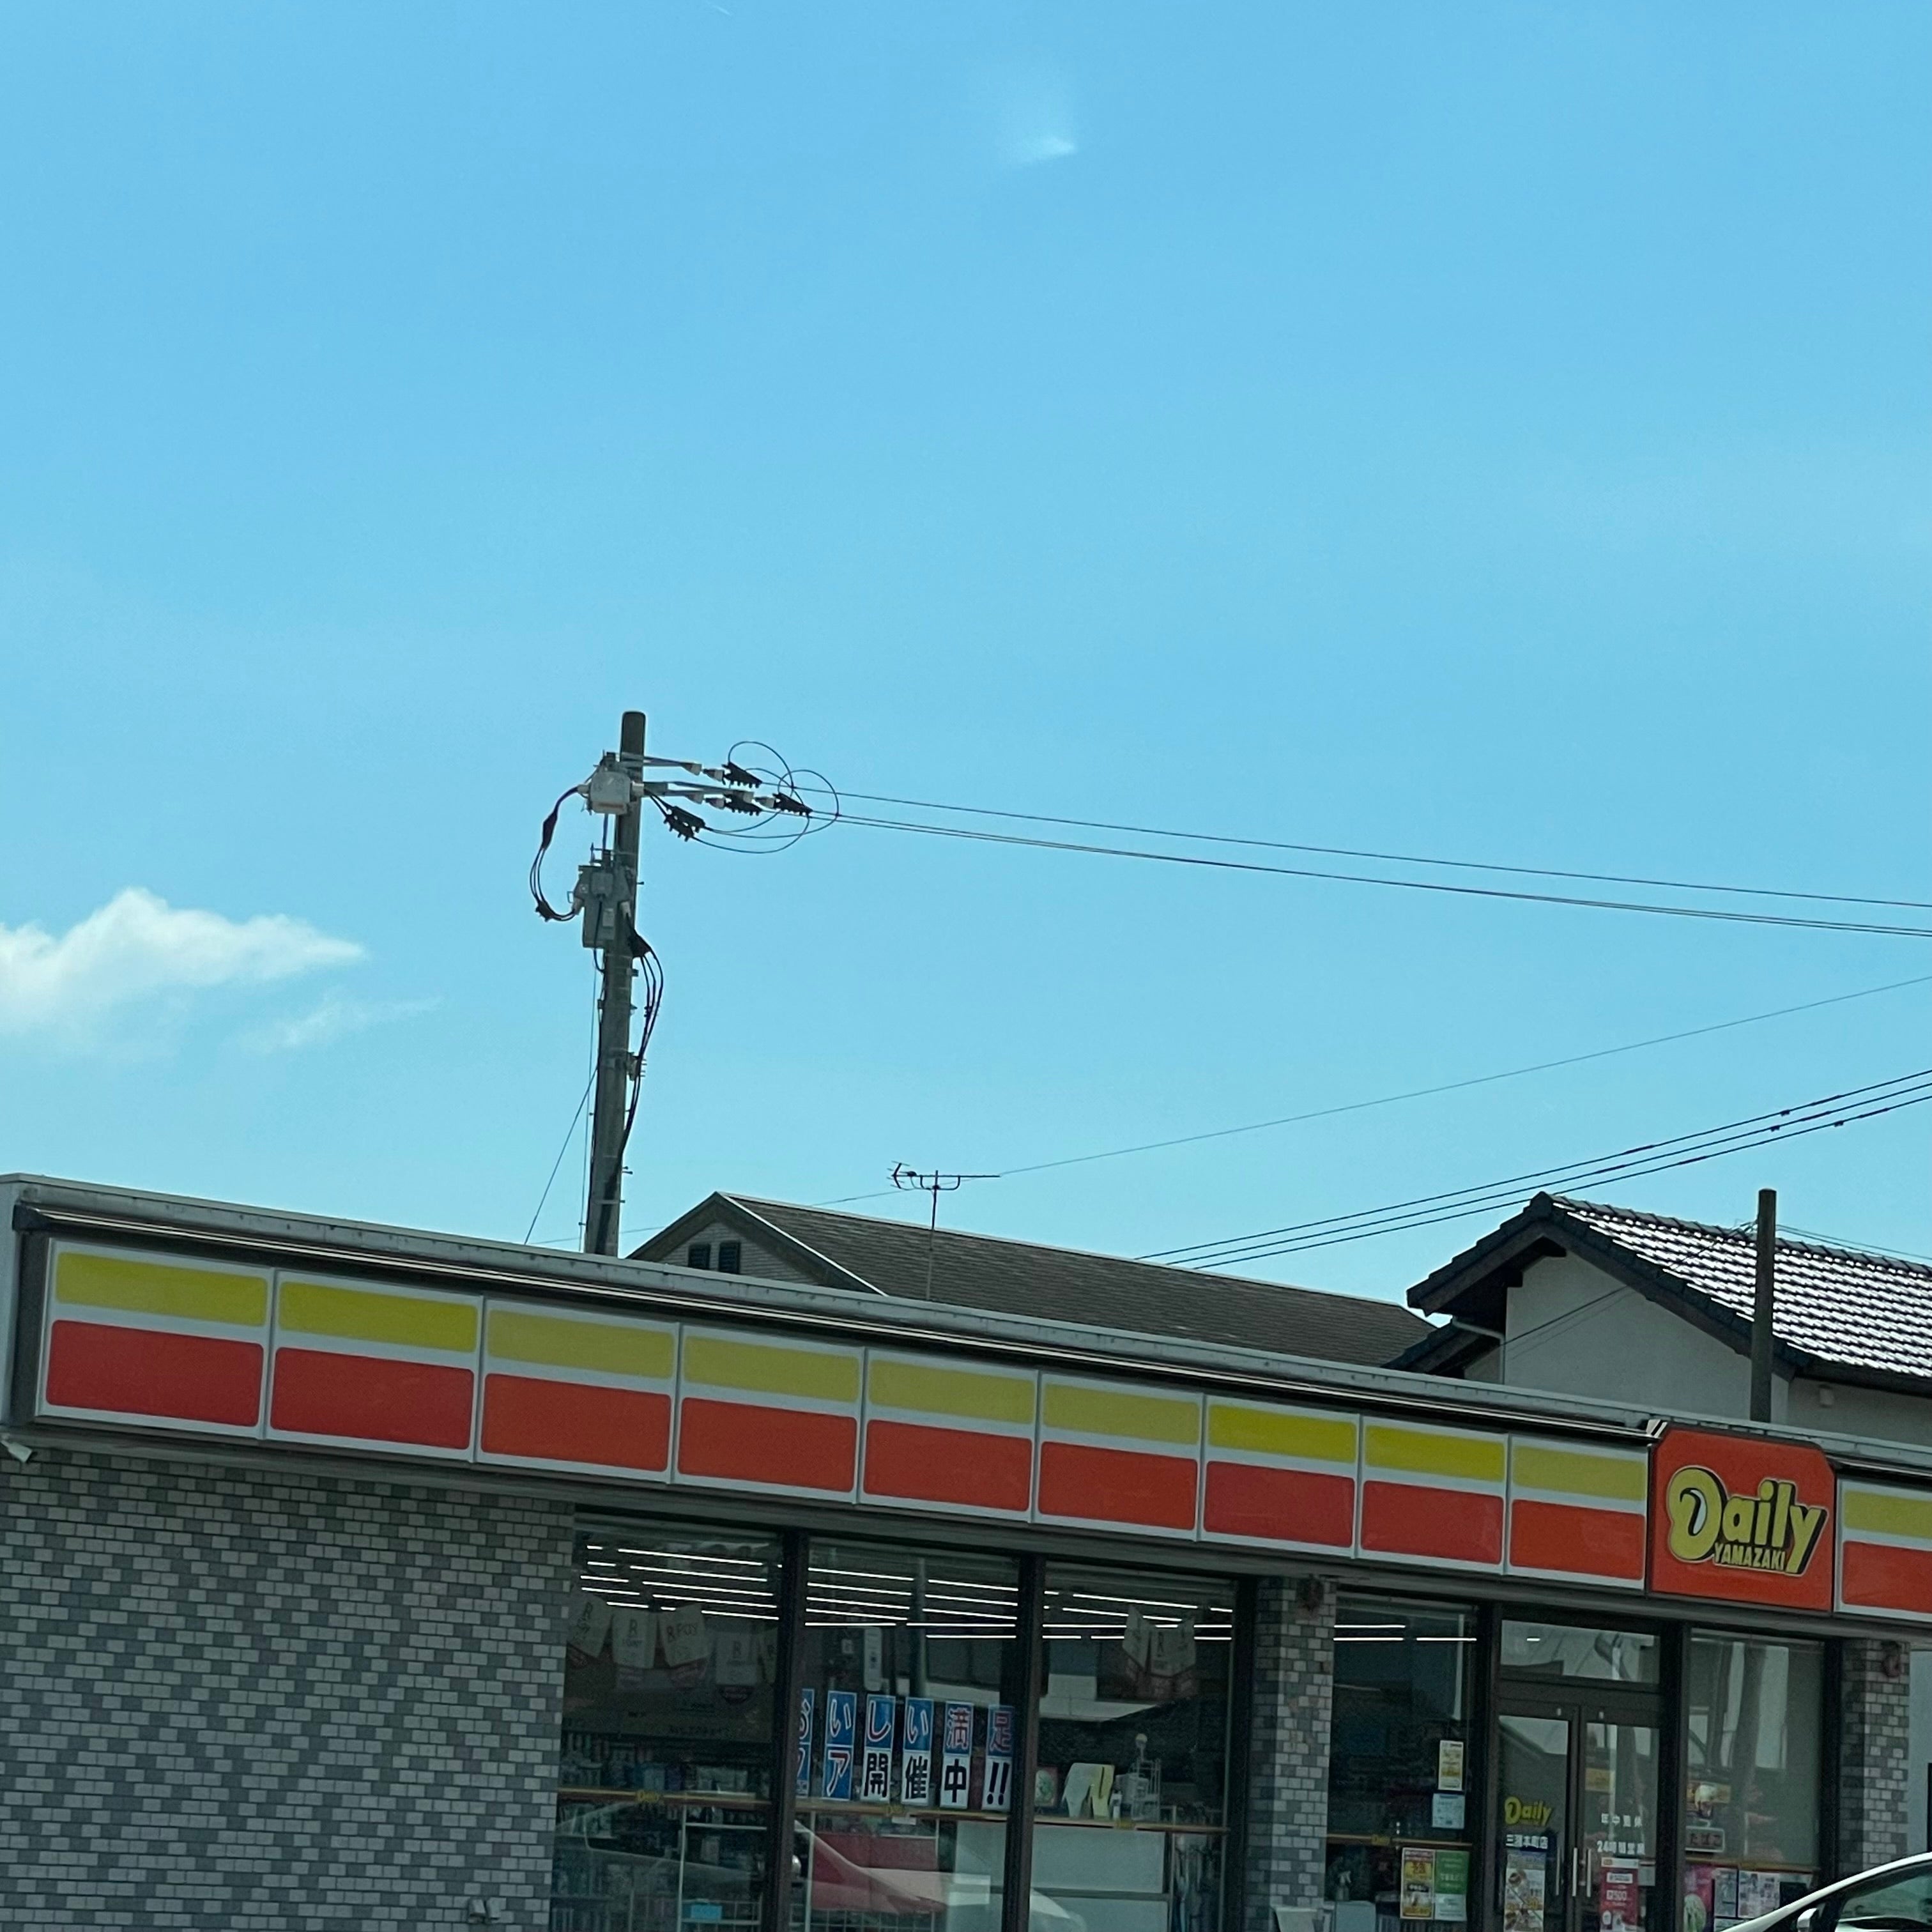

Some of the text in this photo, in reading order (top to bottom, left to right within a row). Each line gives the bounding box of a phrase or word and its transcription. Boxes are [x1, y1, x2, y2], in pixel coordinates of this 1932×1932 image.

[1666, 1465, 1828, 1575] Daily
[1714, 1542, 1786, 1571] YAMAZAKI
[1505, 1796, 1552, 1827] Daily
